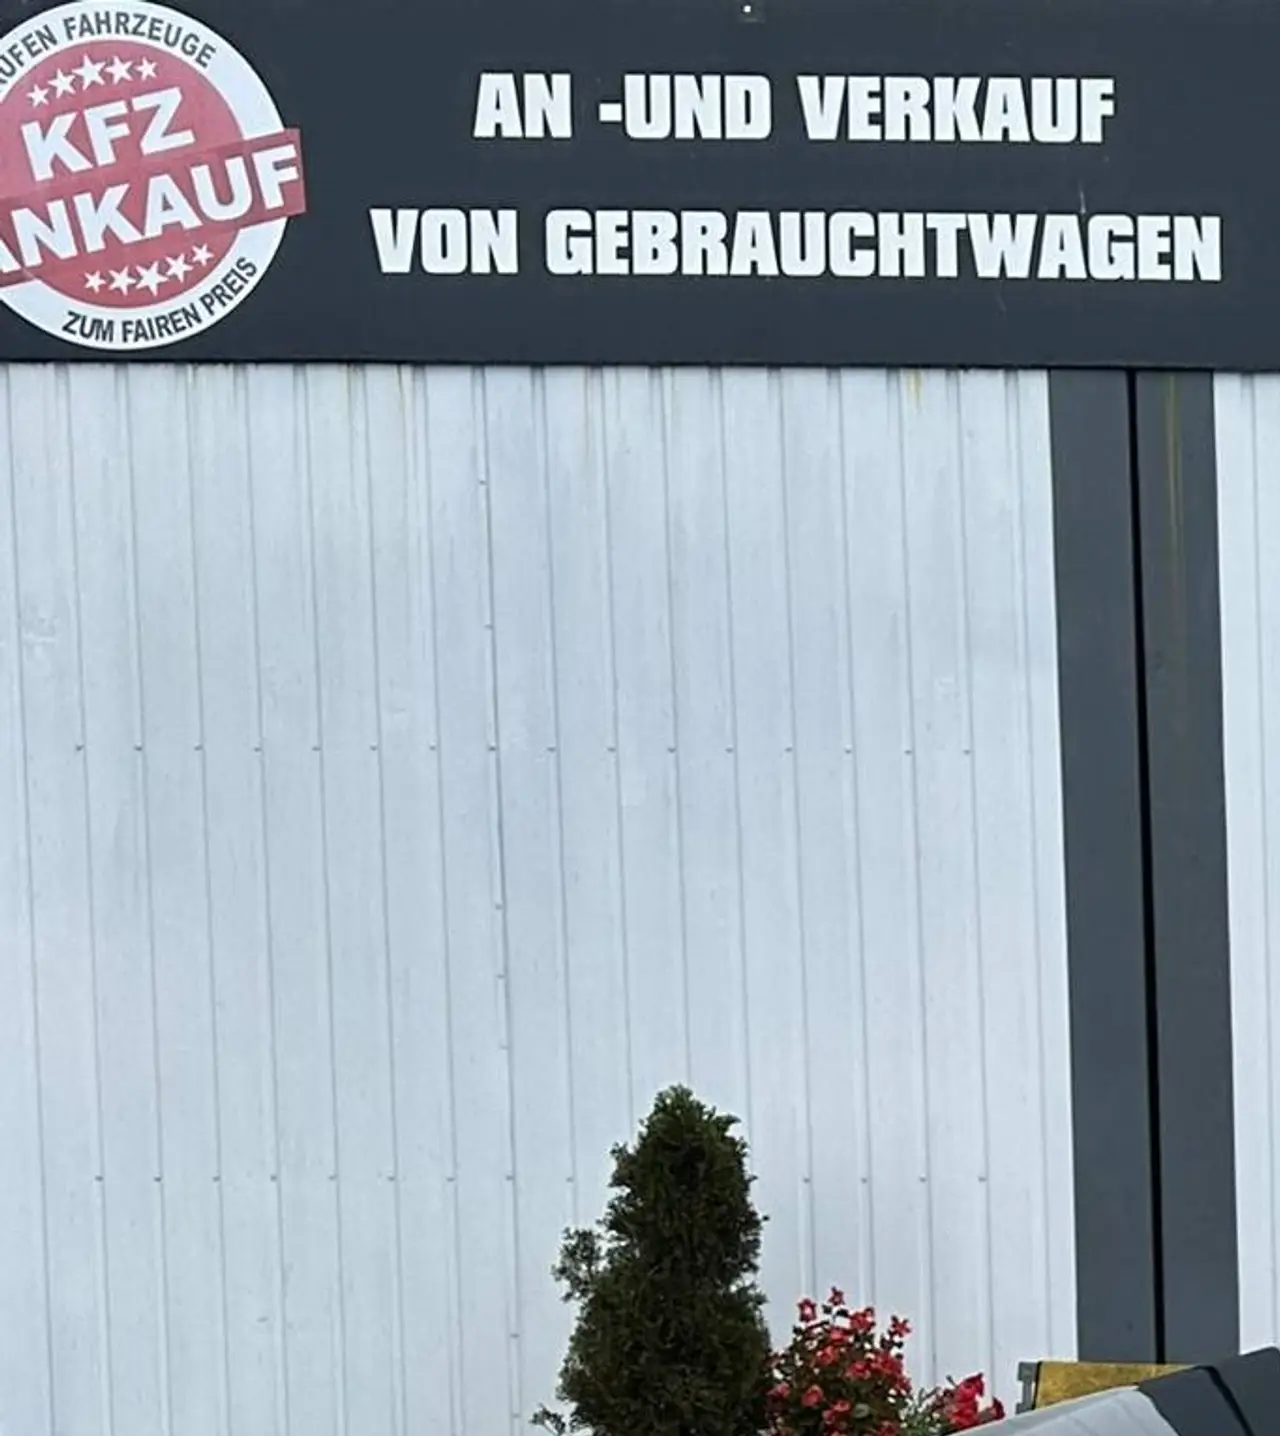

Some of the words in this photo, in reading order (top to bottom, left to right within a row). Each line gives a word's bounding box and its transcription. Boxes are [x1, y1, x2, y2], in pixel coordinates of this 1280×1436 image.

[63, 11, 216, 68] FAHRZEUGE
[20, 86, 196, 182] KFZ
[473, 73, 572, 138] AN
[599, 74, 771, 140] -UND
[797, 76, 1116, 144] VERKAUF
[369, 209, 519, 275] VON
[545, 210, 1224, 282] GEBRAUCHTWAGEN
[61, 310, 114, 343] ZUM
[121, 302, 203, 343] FAIREN
[198, 256, 258, 317] PREIS
